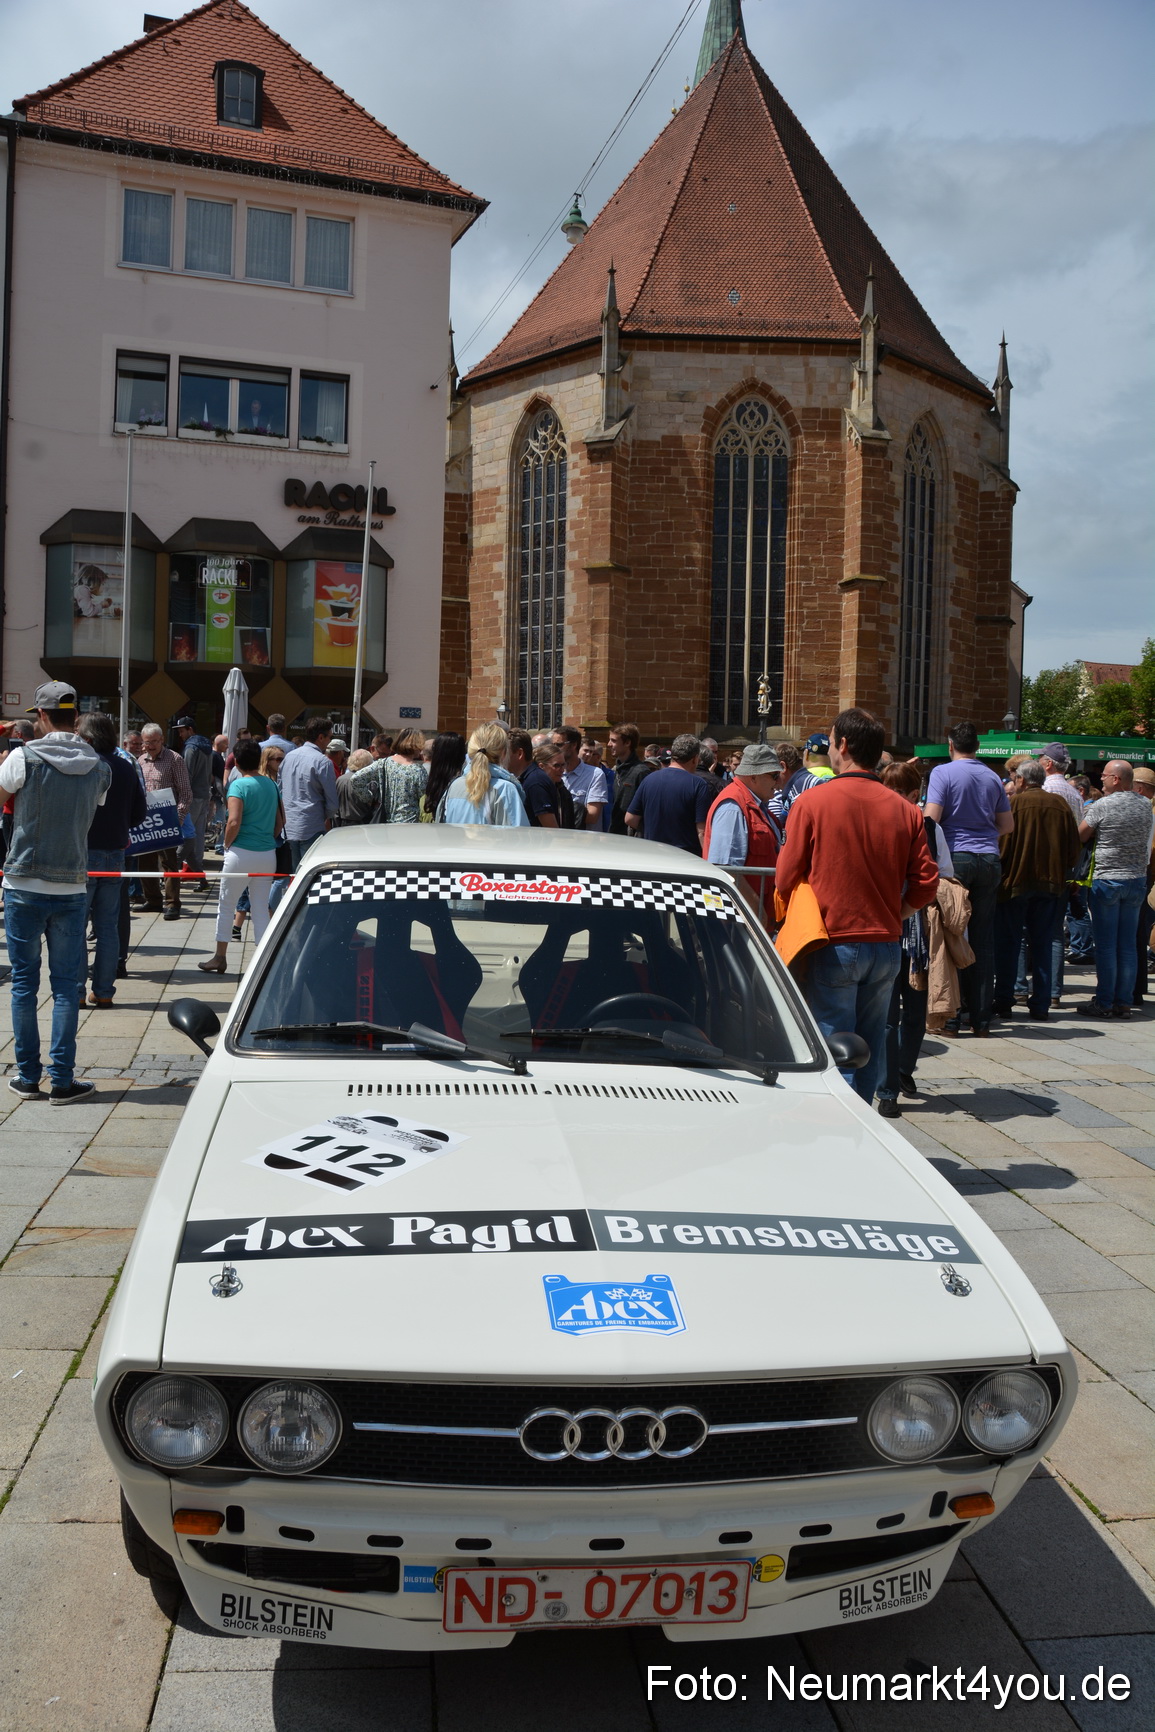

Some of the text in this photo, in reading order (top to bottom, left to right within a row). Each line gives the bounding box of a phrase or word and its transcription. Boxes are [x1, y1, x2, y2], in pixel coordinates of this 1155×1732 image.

[297, 513, 321, 524] am
[202, 567, 238, 586] RACKL
[206, 558, 245, 567] 100 Jahre
[1106, 751, 1144, 760] Neumarkter
[128, 826, 180, 844] business
[459, 873, 582, 902] Boxenstopp
[291, 1135, 407, 1177] 112
[201, 1215, 960, 1260] Abex Pagid Bremsbeläge
[557, 1290, 670, 1320] Abex
[404, 1575, 434, 1584] BILSTEIN
[839, 1568, 932, 1611] BILSTEIN
[584, 1570, 739, 1619] 07013
[842, 1591, 928, 1619] SHOCK ABSORBERS
[220, 1593, 334, 1631] BILSTEIN
[222, 1618, 327, 1640] SHOCK ABSORBERS
